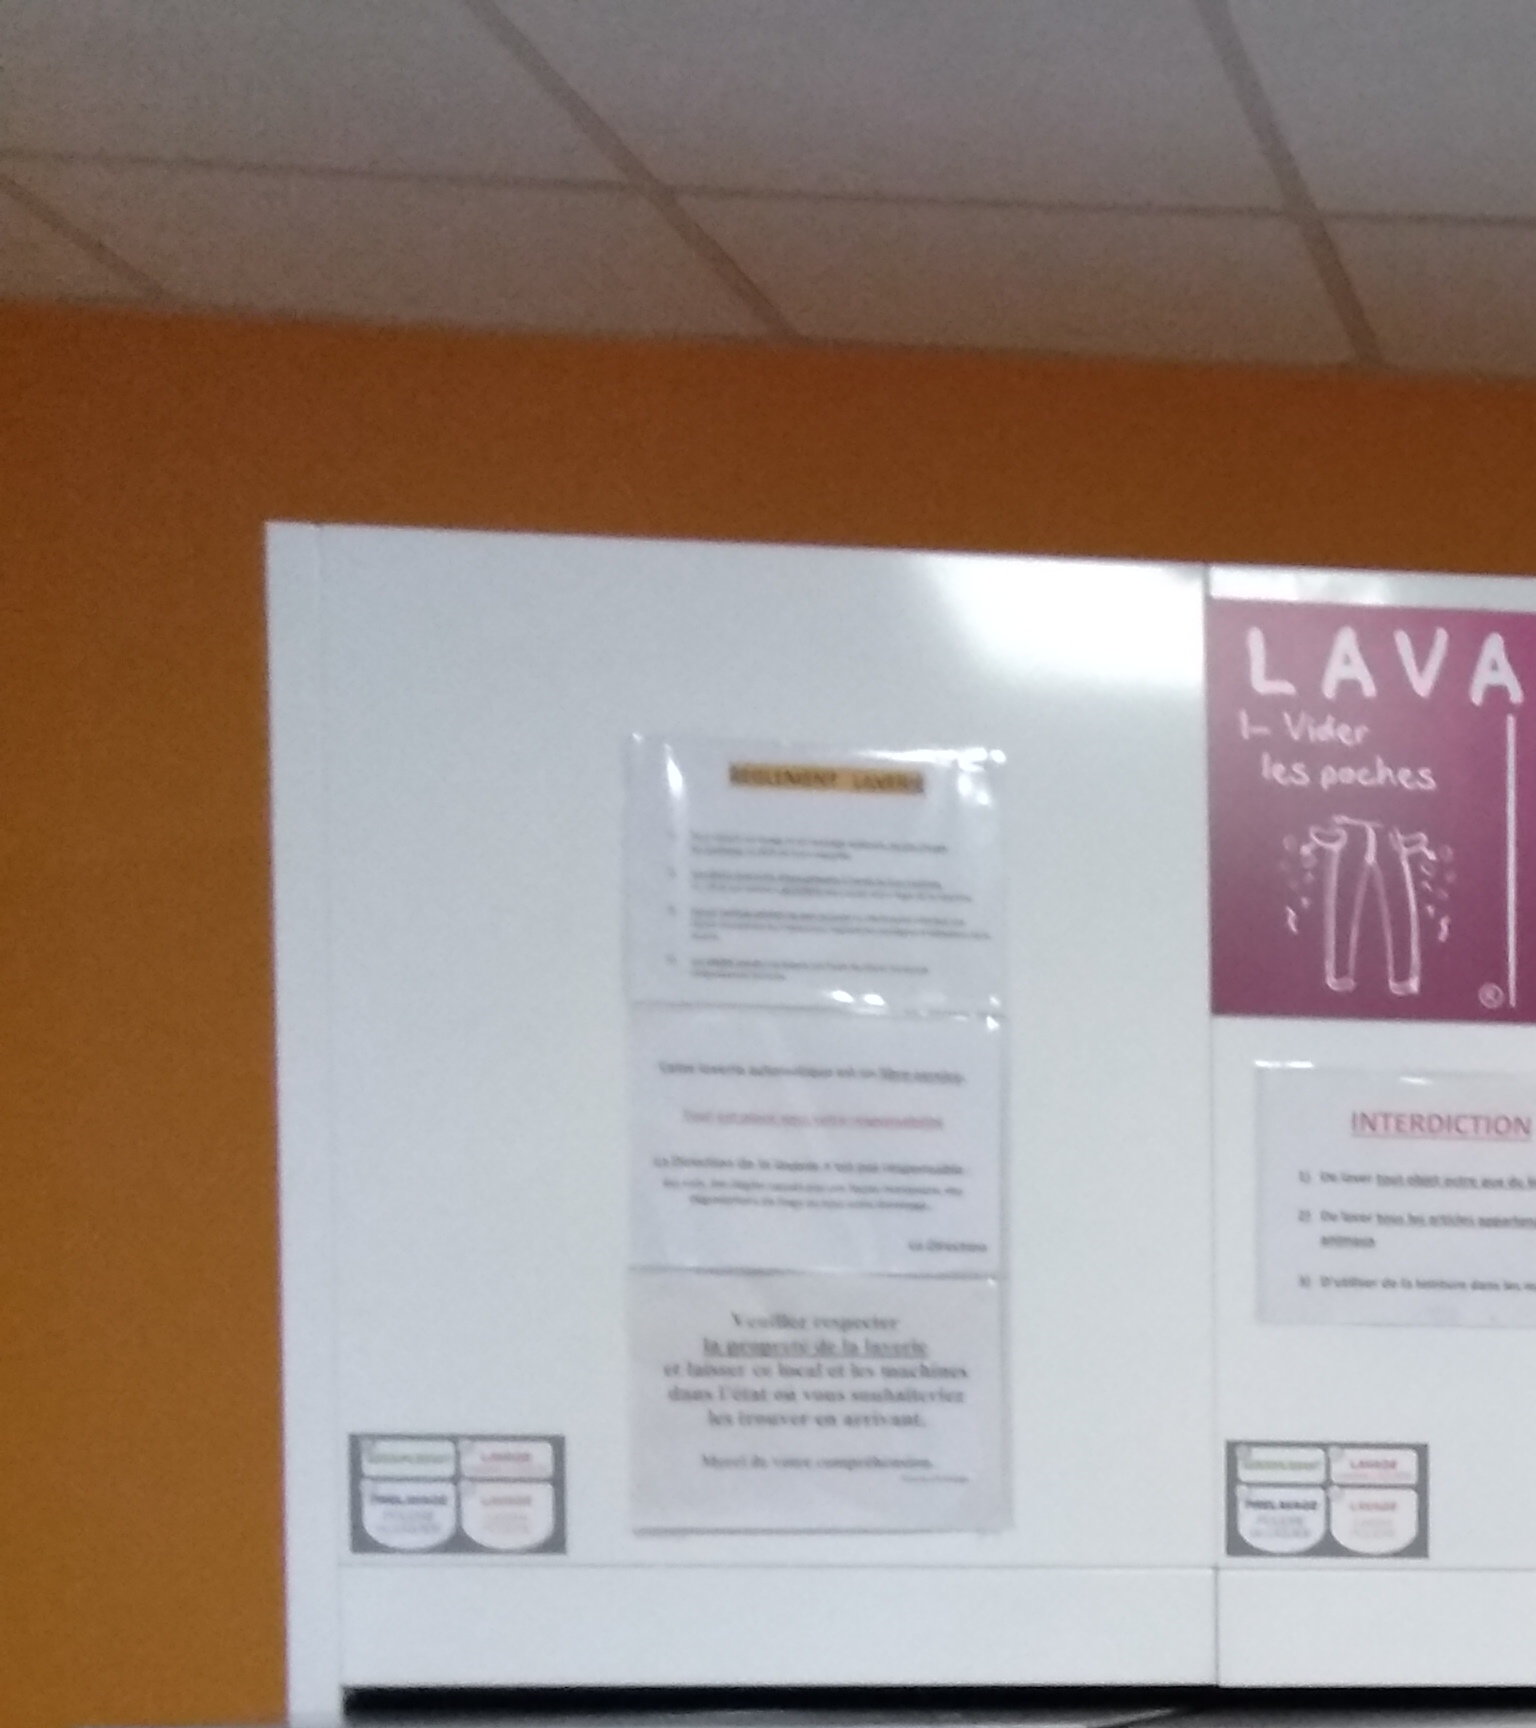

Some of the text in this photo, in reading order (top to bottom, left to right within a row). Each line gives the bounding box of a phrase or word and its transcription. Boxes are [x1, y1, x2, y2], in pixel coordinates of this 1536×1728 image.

[1283, 710, 1370, 746] Vider
[1261, 751, 1437, 791] les poches
[1351, 1111, 1533, 1138] INTERDICTION
